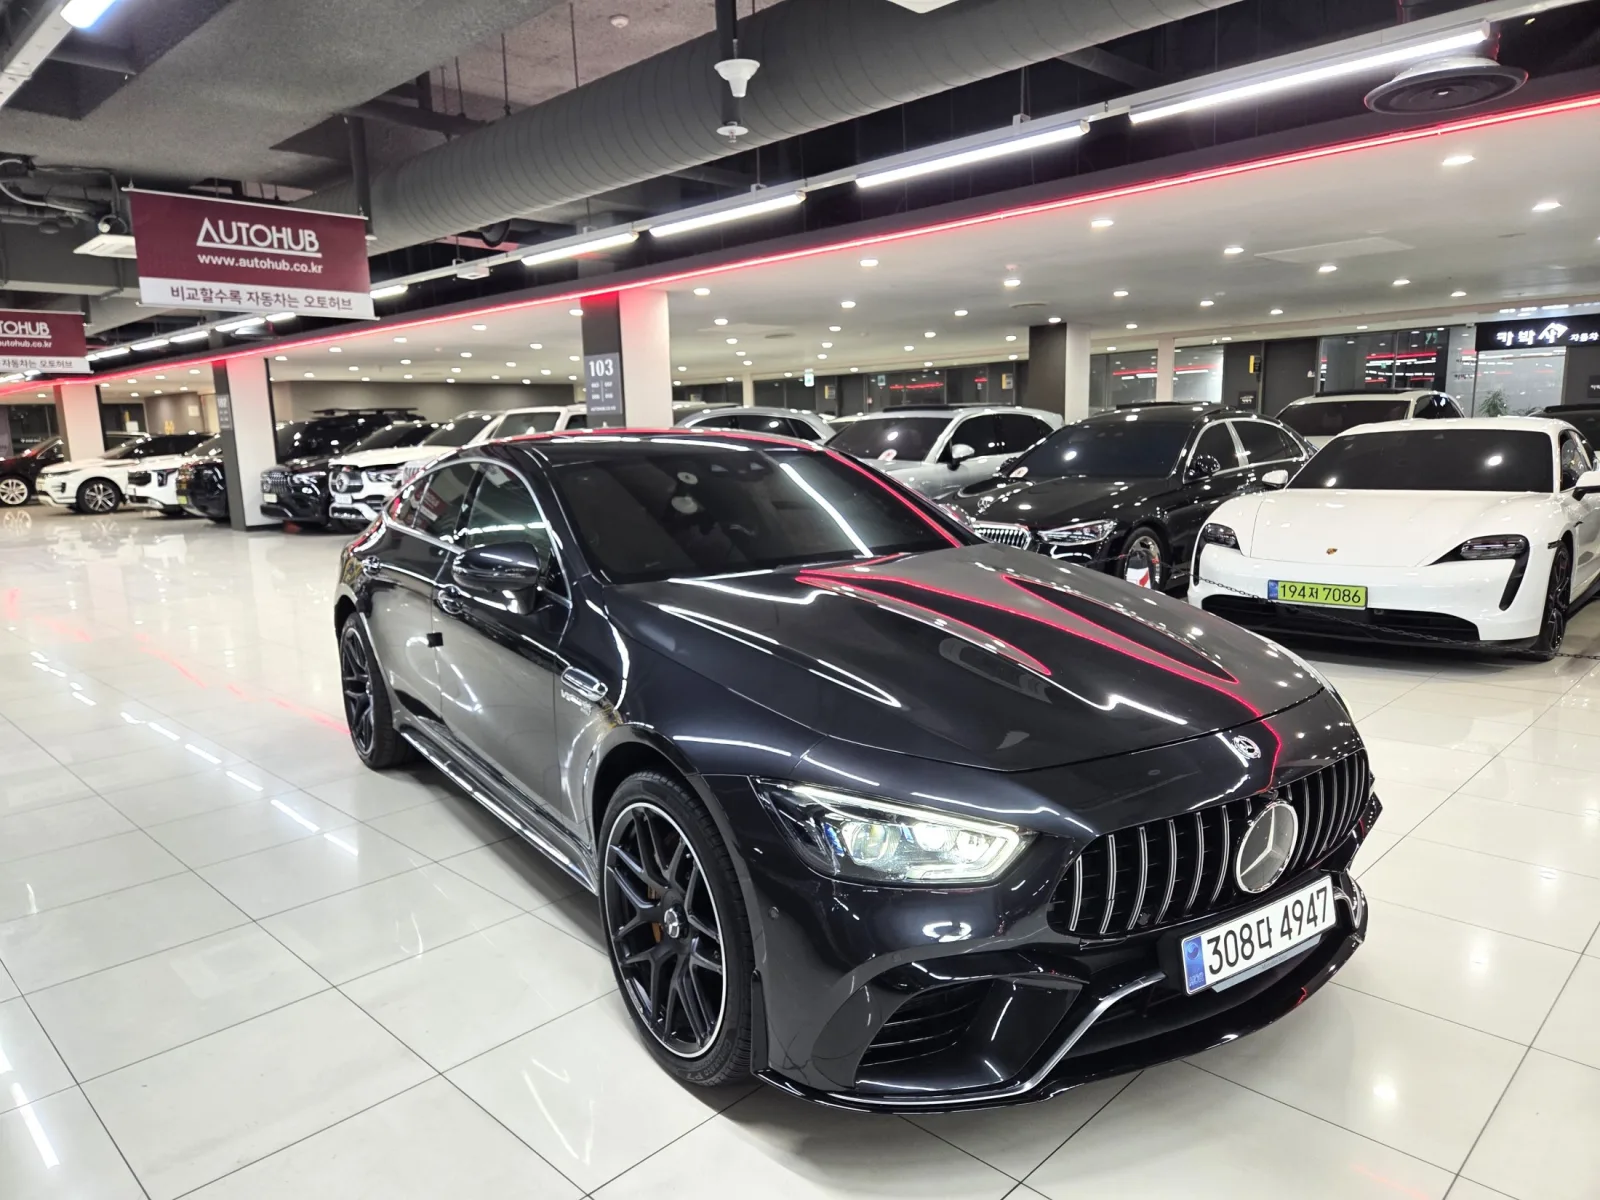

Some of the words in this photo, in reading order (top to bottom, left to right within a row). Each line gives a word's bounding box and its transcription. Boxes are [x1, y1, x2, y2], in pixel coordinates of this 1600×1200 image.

[196, 217, 322, 257] AUTOHUB
[197, 253, 323, 274] www.autohub.co.kr
[170, 285, 242, 304] 비교할수록
[247, 291, 300, 308] 자동차는
[303, 295, 353, 311] 오토허브
[589, 358, 613, 377] 103
[1281, 584, 1319, 600] 194저
[1323, 587, 1361, 604] 7086
[1207, 916, 1273, 975] 308다
[1280, 886, 1328, 941] 4947
